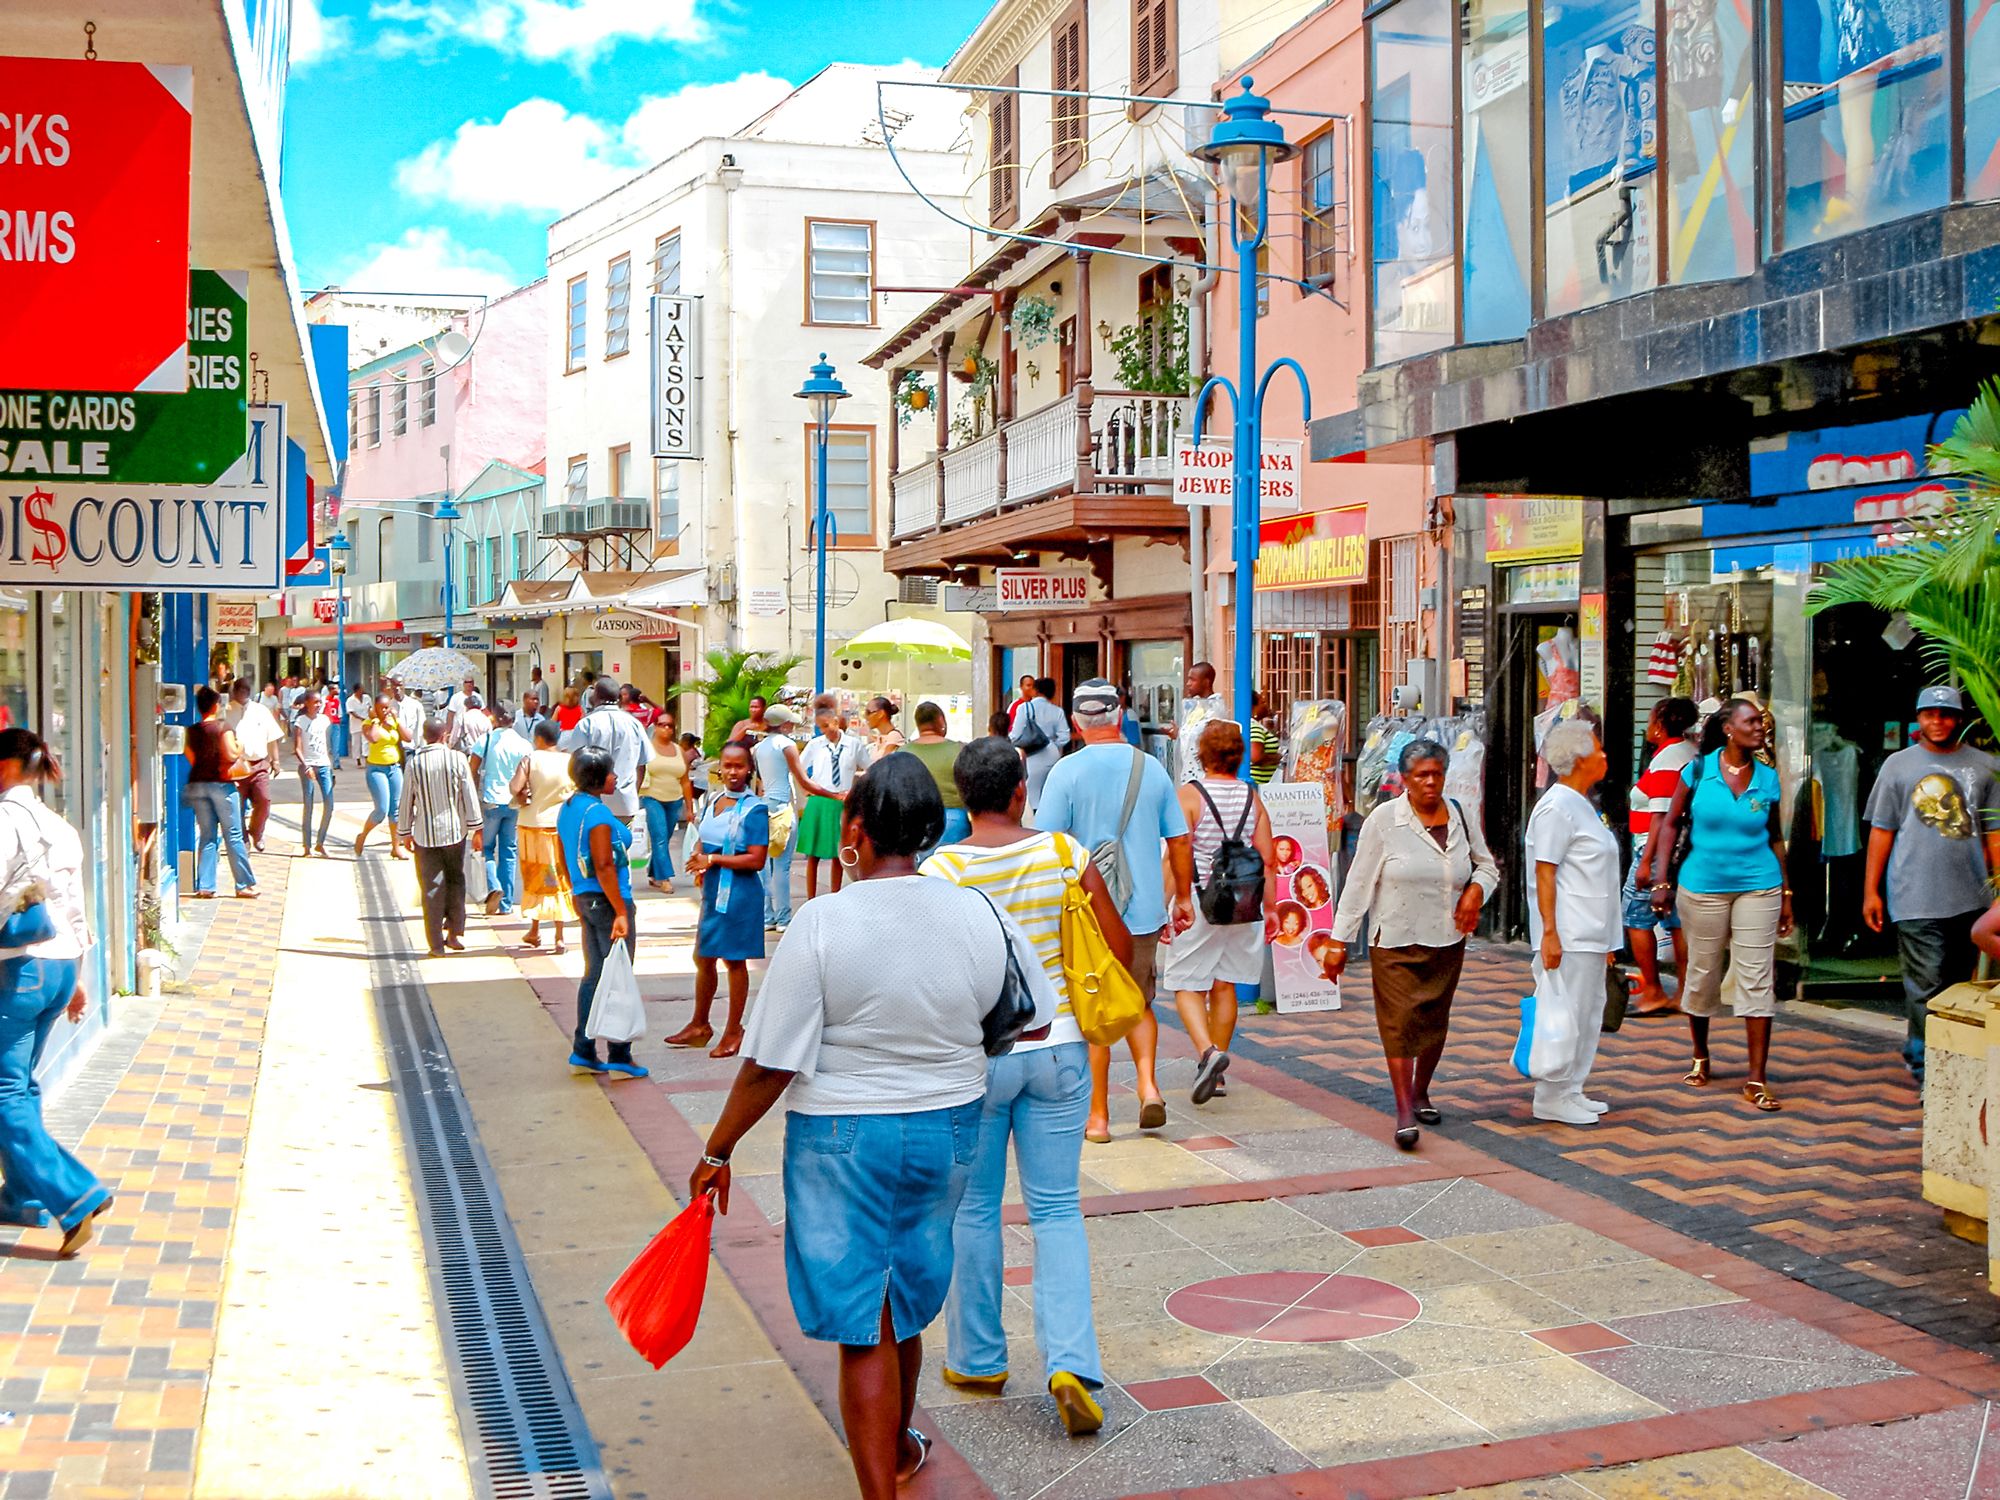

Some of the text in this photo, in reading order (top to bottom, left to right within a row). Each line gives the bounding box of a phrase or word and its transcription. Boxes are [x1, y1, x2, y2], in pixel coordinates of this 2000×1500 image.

[188, 308, 232, 342] IES
[665, 303, 685, 447] JAYSONS
[50, 396, 136, 431] CARDS
[1179, 450, 1294, 471] TROPNA
[1179, 478, 1294, 497] JEWEERS
[1307, 533, 1365, 580] JEWELLERS
[1001, 578, 1048, 600] SILVER
[1053, 577, 1086, 599] PLUS
[596, 620, 643, 631] JAYSONS
[375, 634, 410, 646] Digicel
[1263, 788, 1322, 801] SAMANTHA'S
